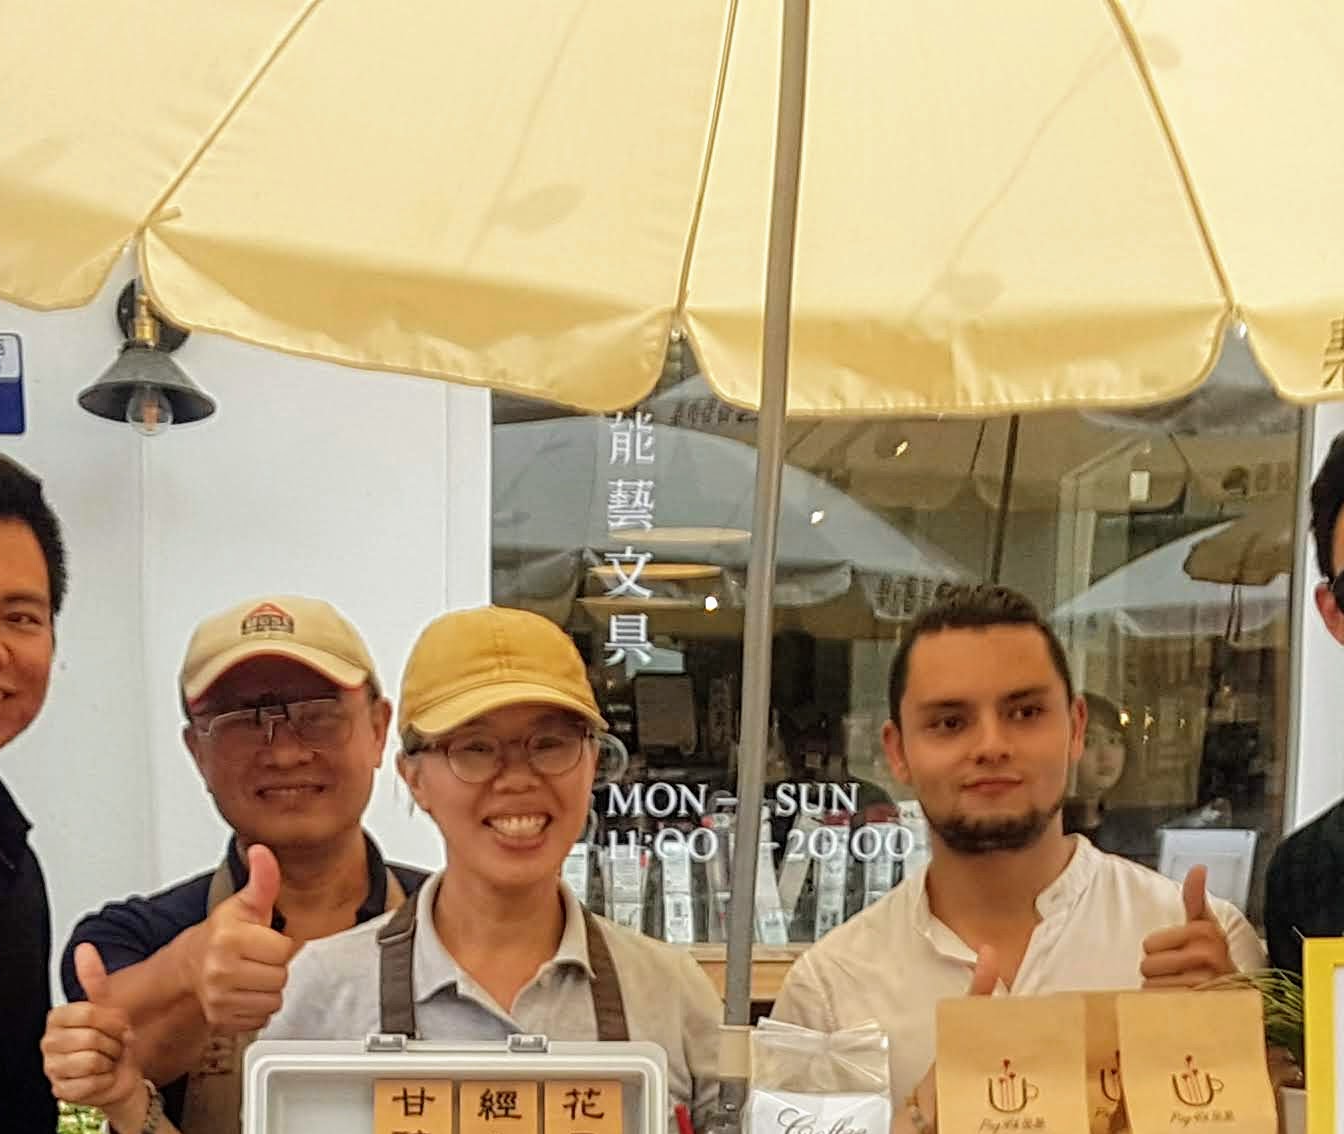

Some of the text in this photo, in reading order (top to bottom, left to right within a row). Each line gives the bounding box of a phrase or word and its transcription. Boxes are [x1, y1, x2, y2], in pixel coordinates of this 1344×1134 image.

[603, 411, 656, 668] 能藝文具
[606, 780, 861, 818] MON SUN
